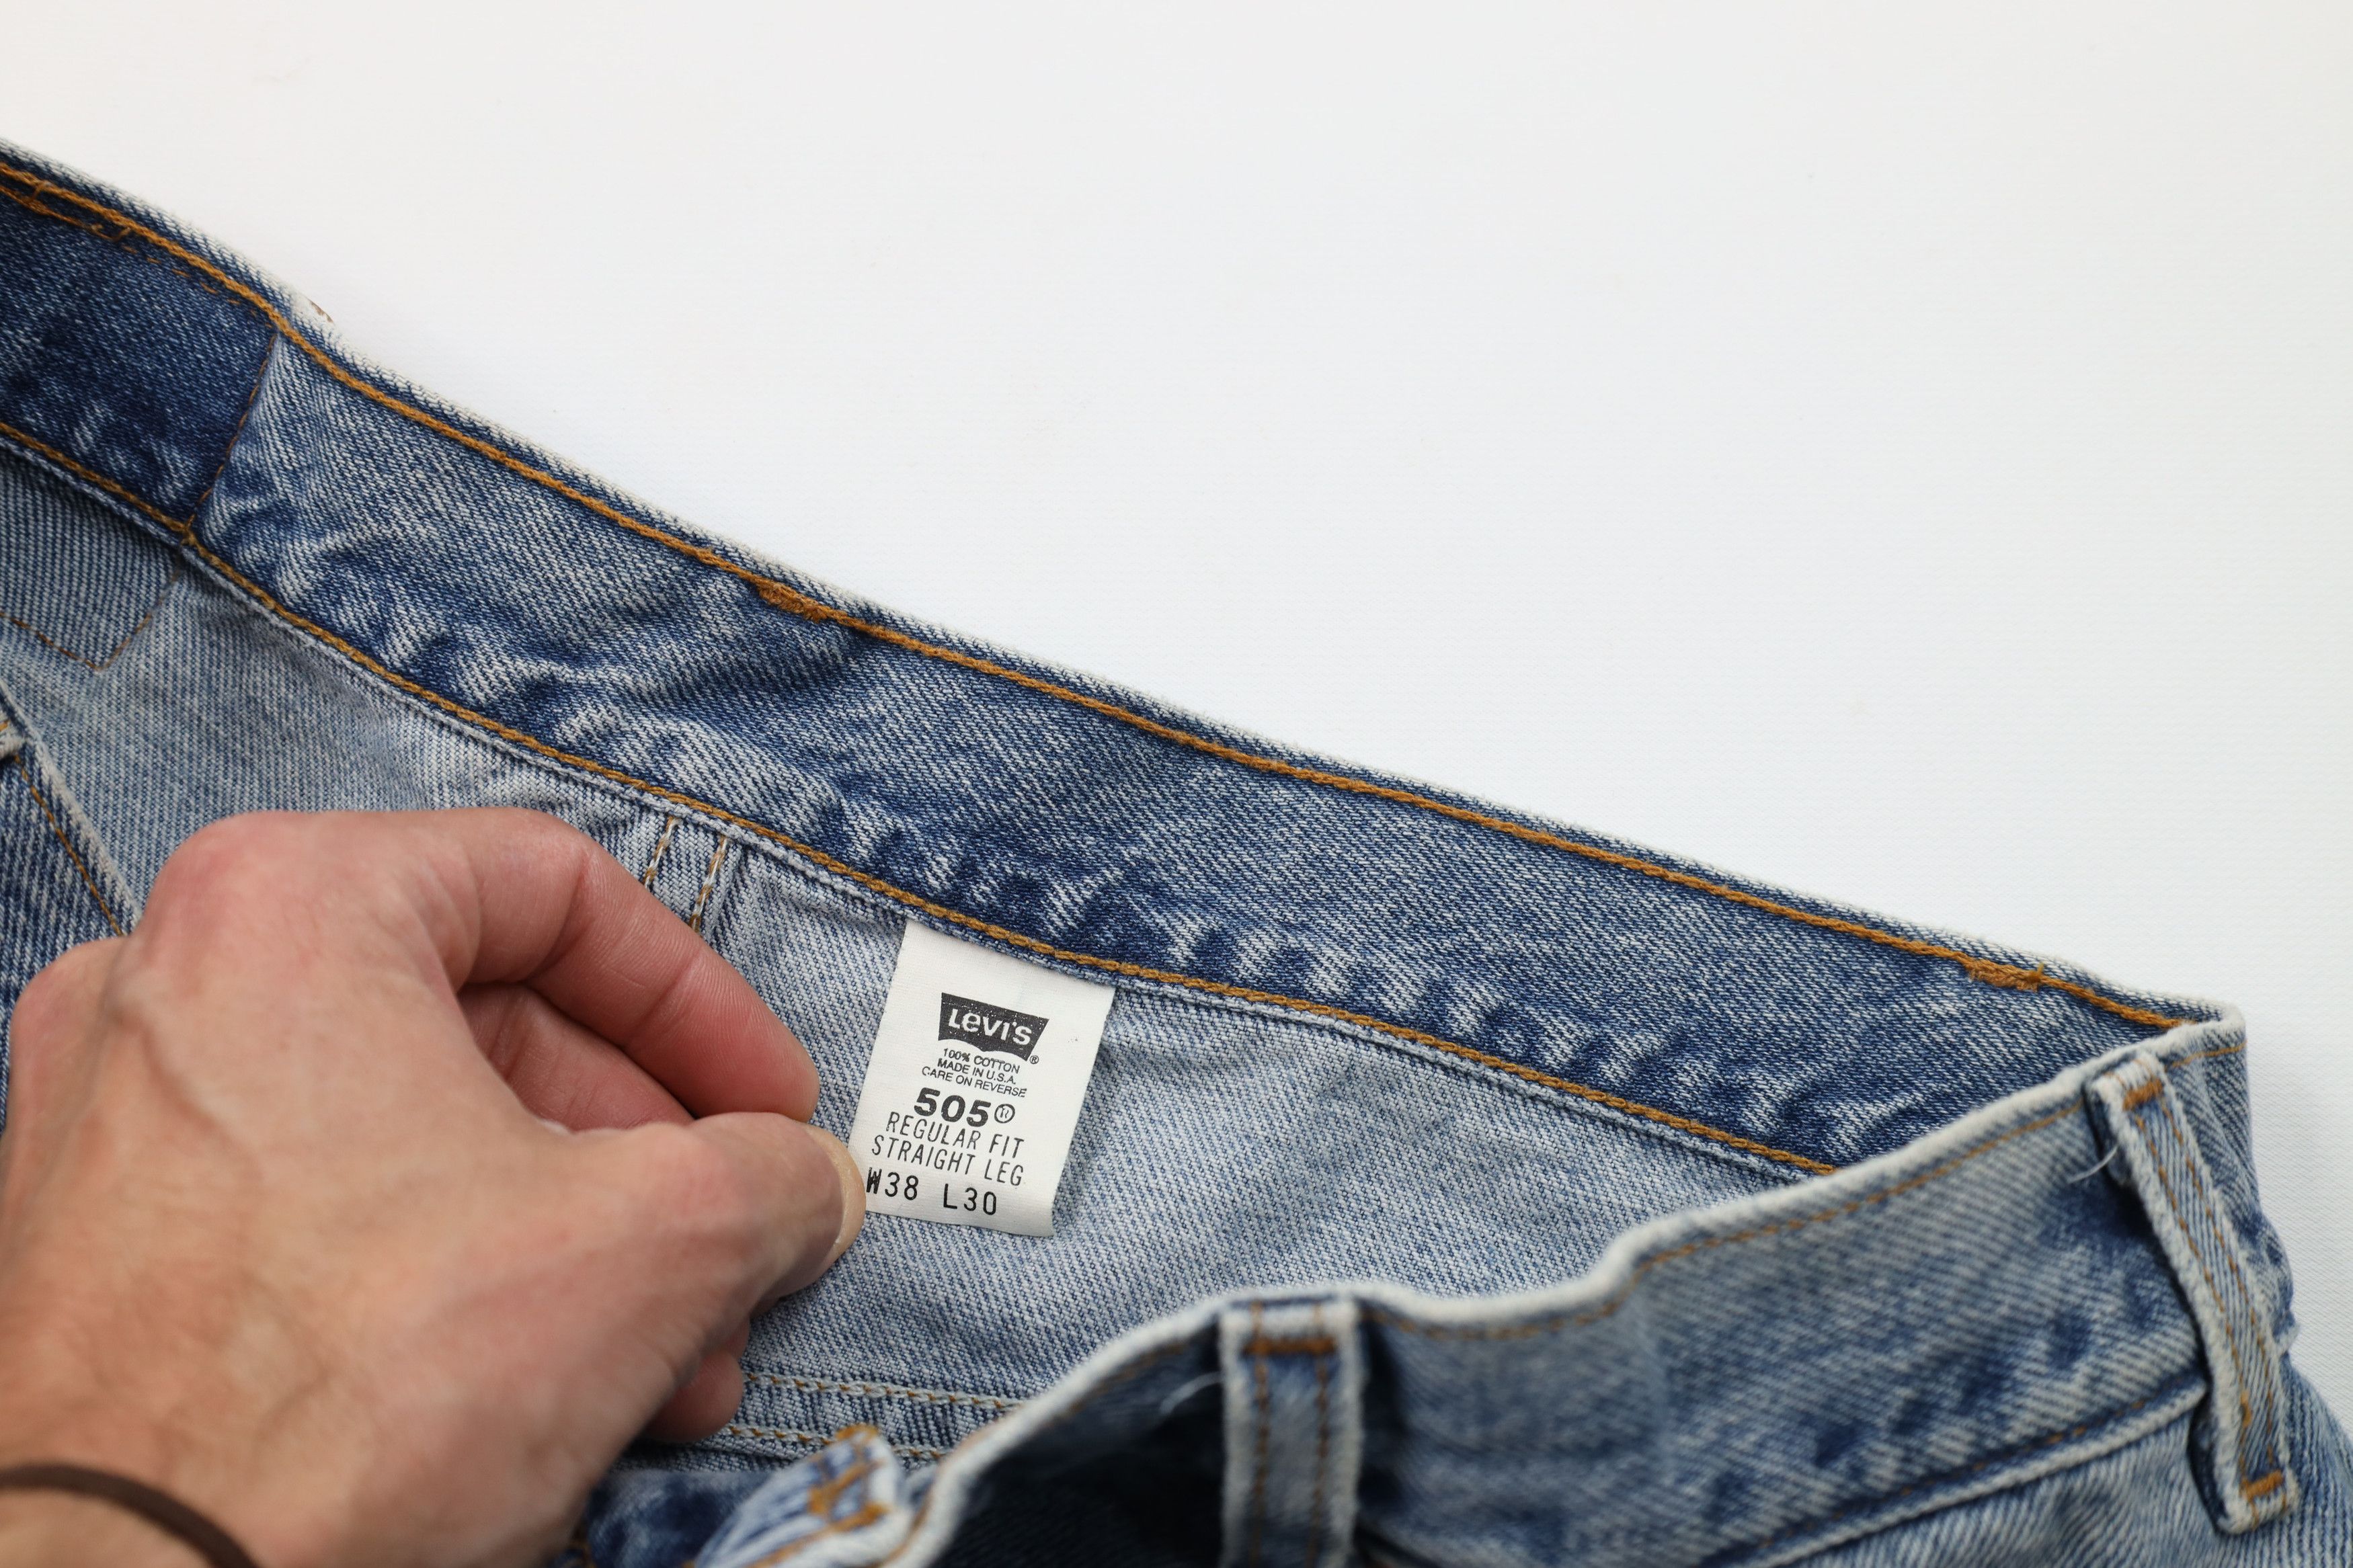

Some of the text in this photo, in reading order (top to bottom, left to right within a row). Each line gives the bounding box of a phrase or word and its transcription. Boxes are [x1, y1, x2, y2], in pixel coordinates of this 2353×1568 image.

[938, 1058, 1016, 1084] MADE IN U.S.A.
[943, 1048, 1020, 1073] 100% COTTON
[922, 1067, 1027, 1098] CARE ON REVERSE
[886, 1112, 1025, 1159] REGULAR FIT
[871, 1134, 1024, 1186] STRAIGHT LEG
[866, 1167, 996, 1215] W38 L30
